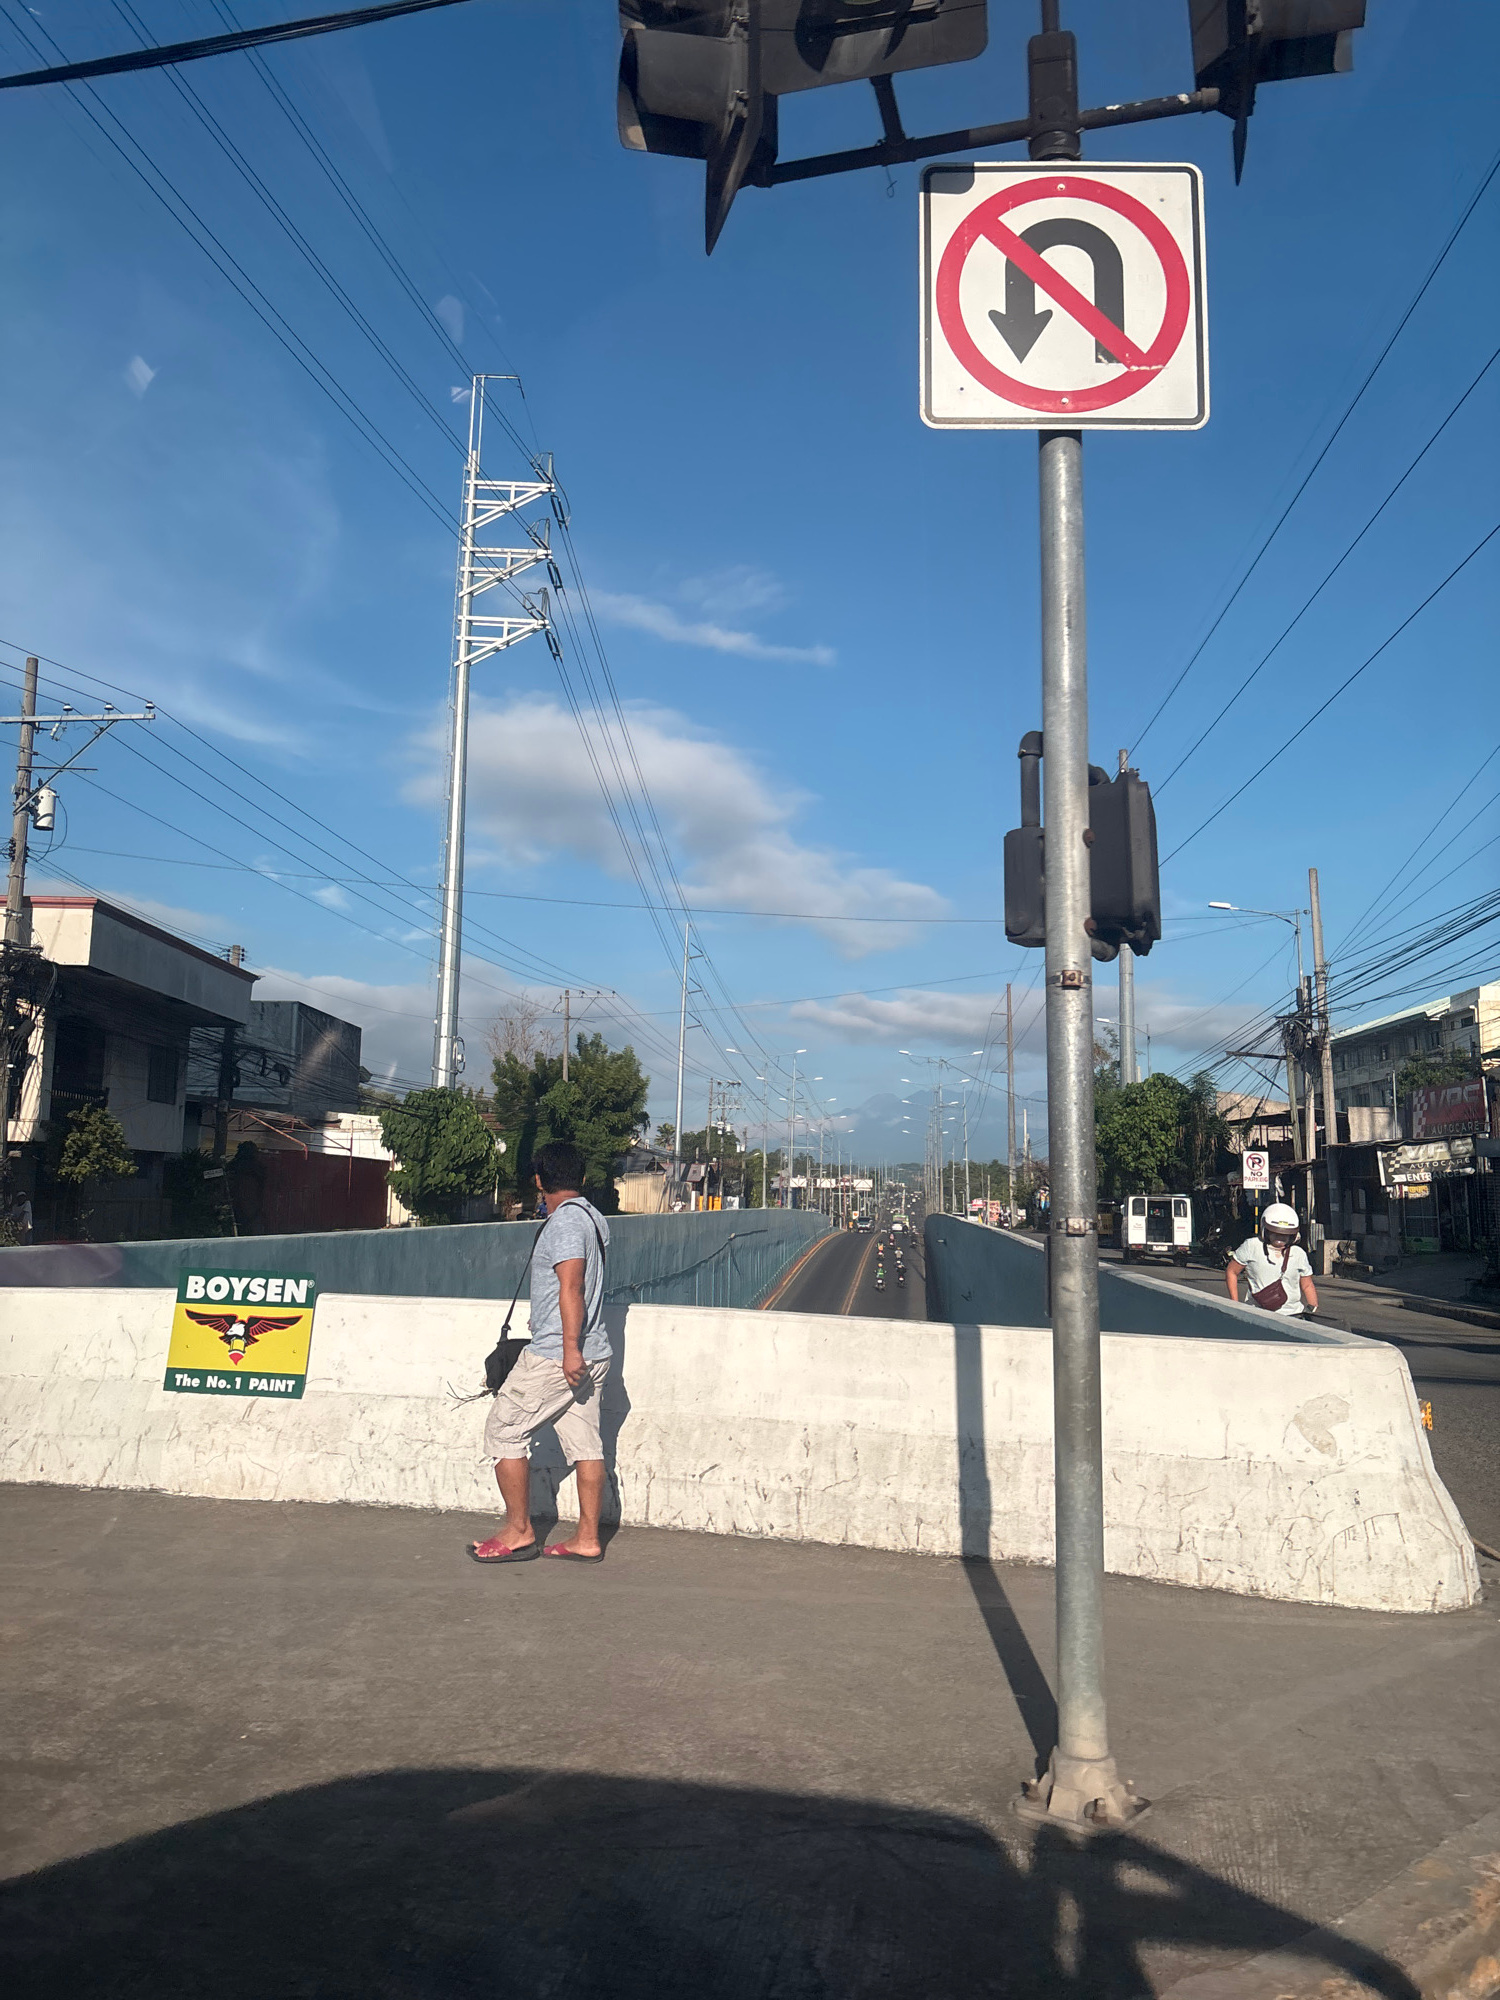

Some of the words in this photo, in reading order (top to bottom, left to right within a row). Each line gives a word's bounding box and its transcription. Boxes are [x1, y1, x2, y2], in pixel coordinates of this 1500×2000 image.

[1431, 1121, 1480, 1134] AUTOCARE
[1409, 1158, 1471, 1170] AUTOCARE
[1407, 1168, 1460, 1182] ENTRANCE
[185, 1275, 309, 1304] BOYSEN
[174, 1374, 201, 1388] The
[248, 1378, 296, 1393] PAINT
